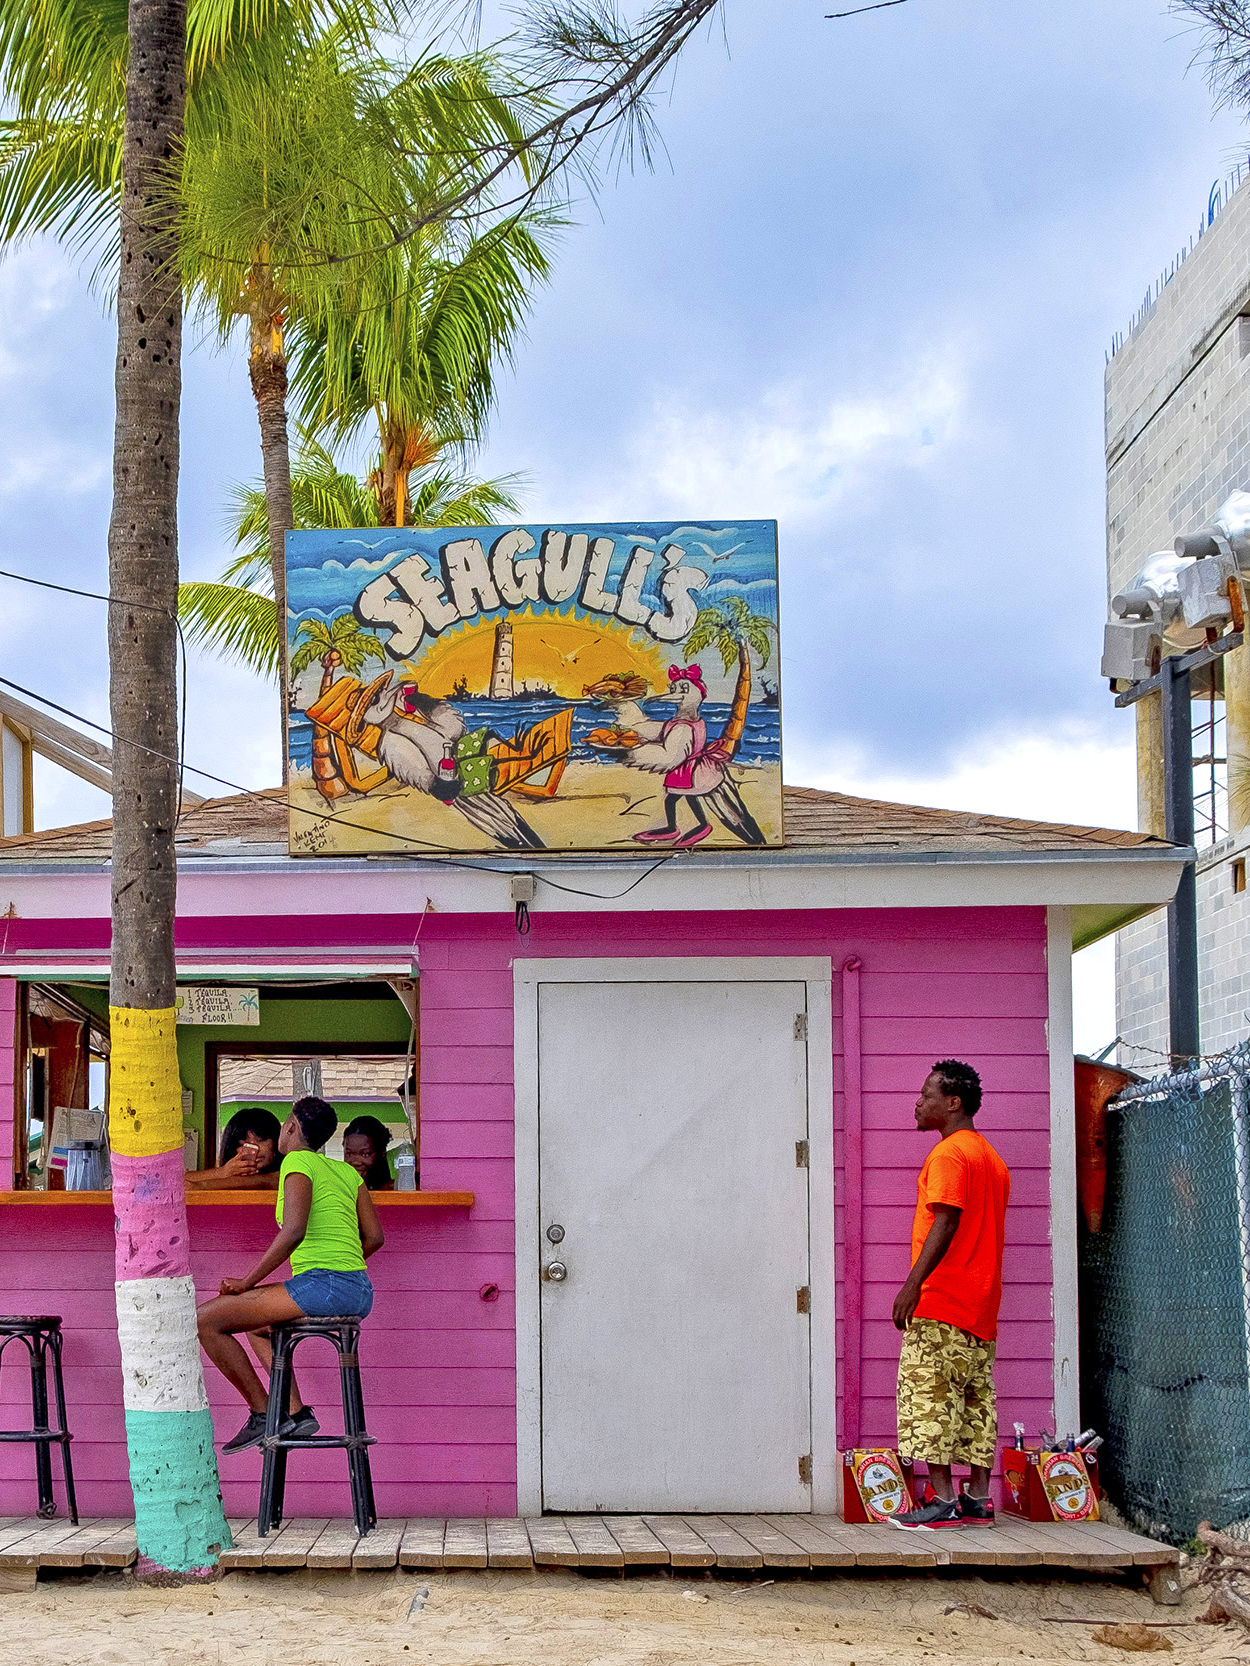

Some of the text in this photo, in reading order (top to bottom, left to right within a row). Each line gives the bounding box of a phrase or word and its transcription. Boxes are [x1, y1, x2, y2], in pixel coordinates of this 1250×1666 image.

[353, 528, 708, 661] SEAGULL'S
[187, 989, 191, 998] 1
[189, 1006, 194, 1014] 3
